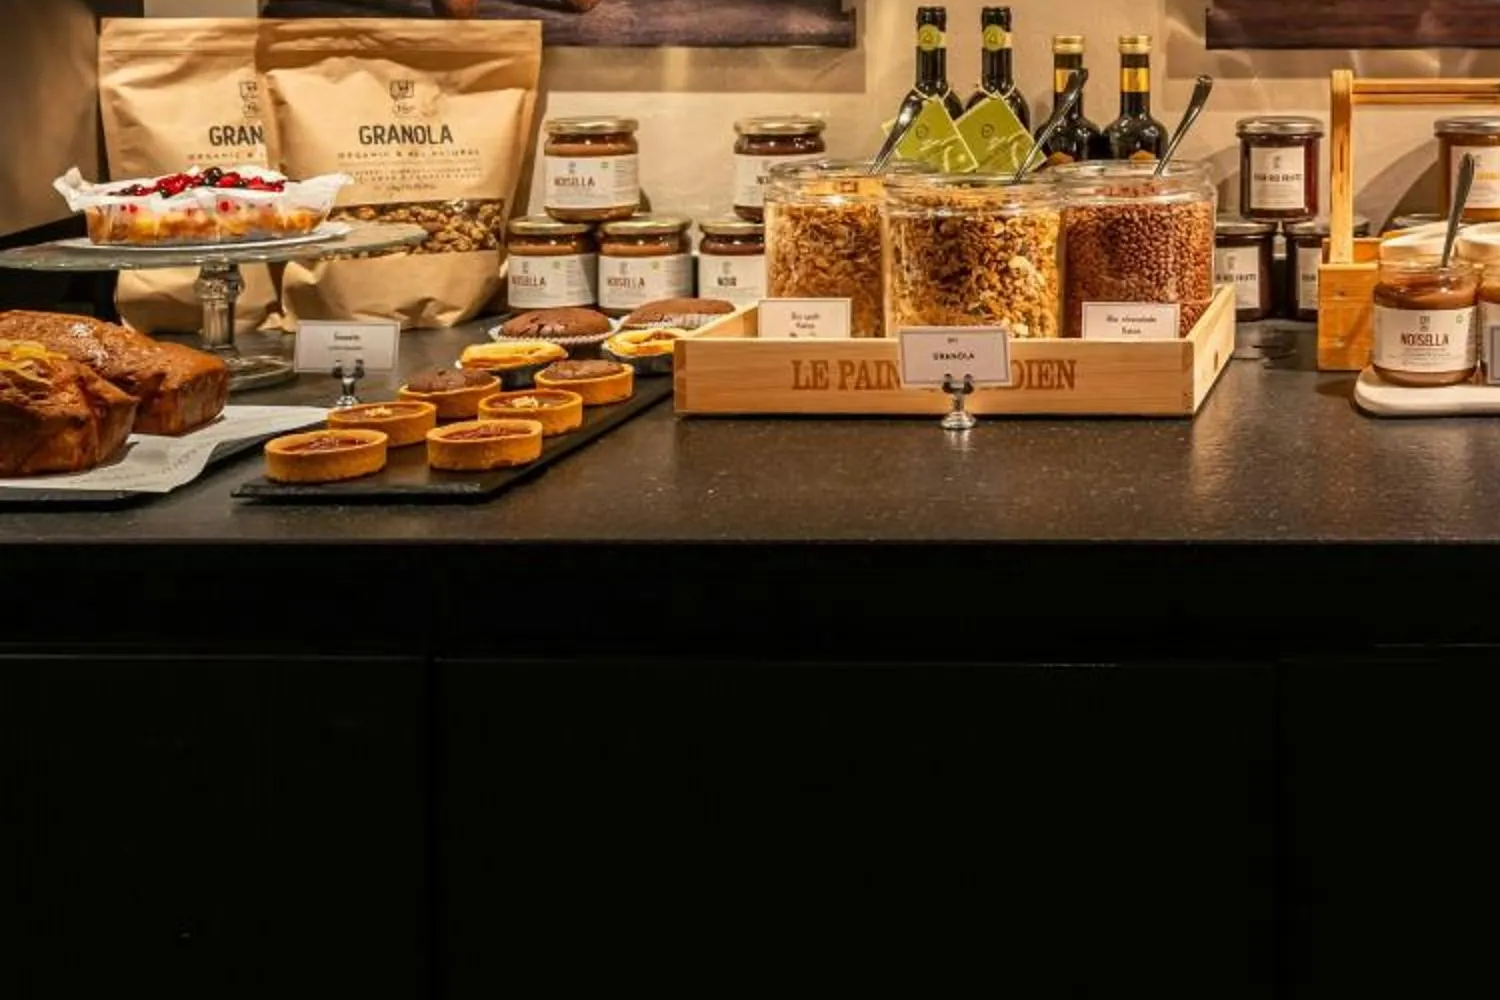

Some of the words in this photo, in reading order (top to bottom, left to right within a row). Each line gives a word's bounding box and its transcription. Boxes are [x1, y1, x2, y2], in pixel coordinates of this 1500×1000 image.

[209, 125, 264, 146] GRAN
[358, 124, 453, 145] GRANOLA
[1400, 332, 1449, 347] NOISELLA
[791, 359, 828, 391] LE
[838, 359, 900, 391] PAIN
[1010, 359, 1077, 391] DIEN
